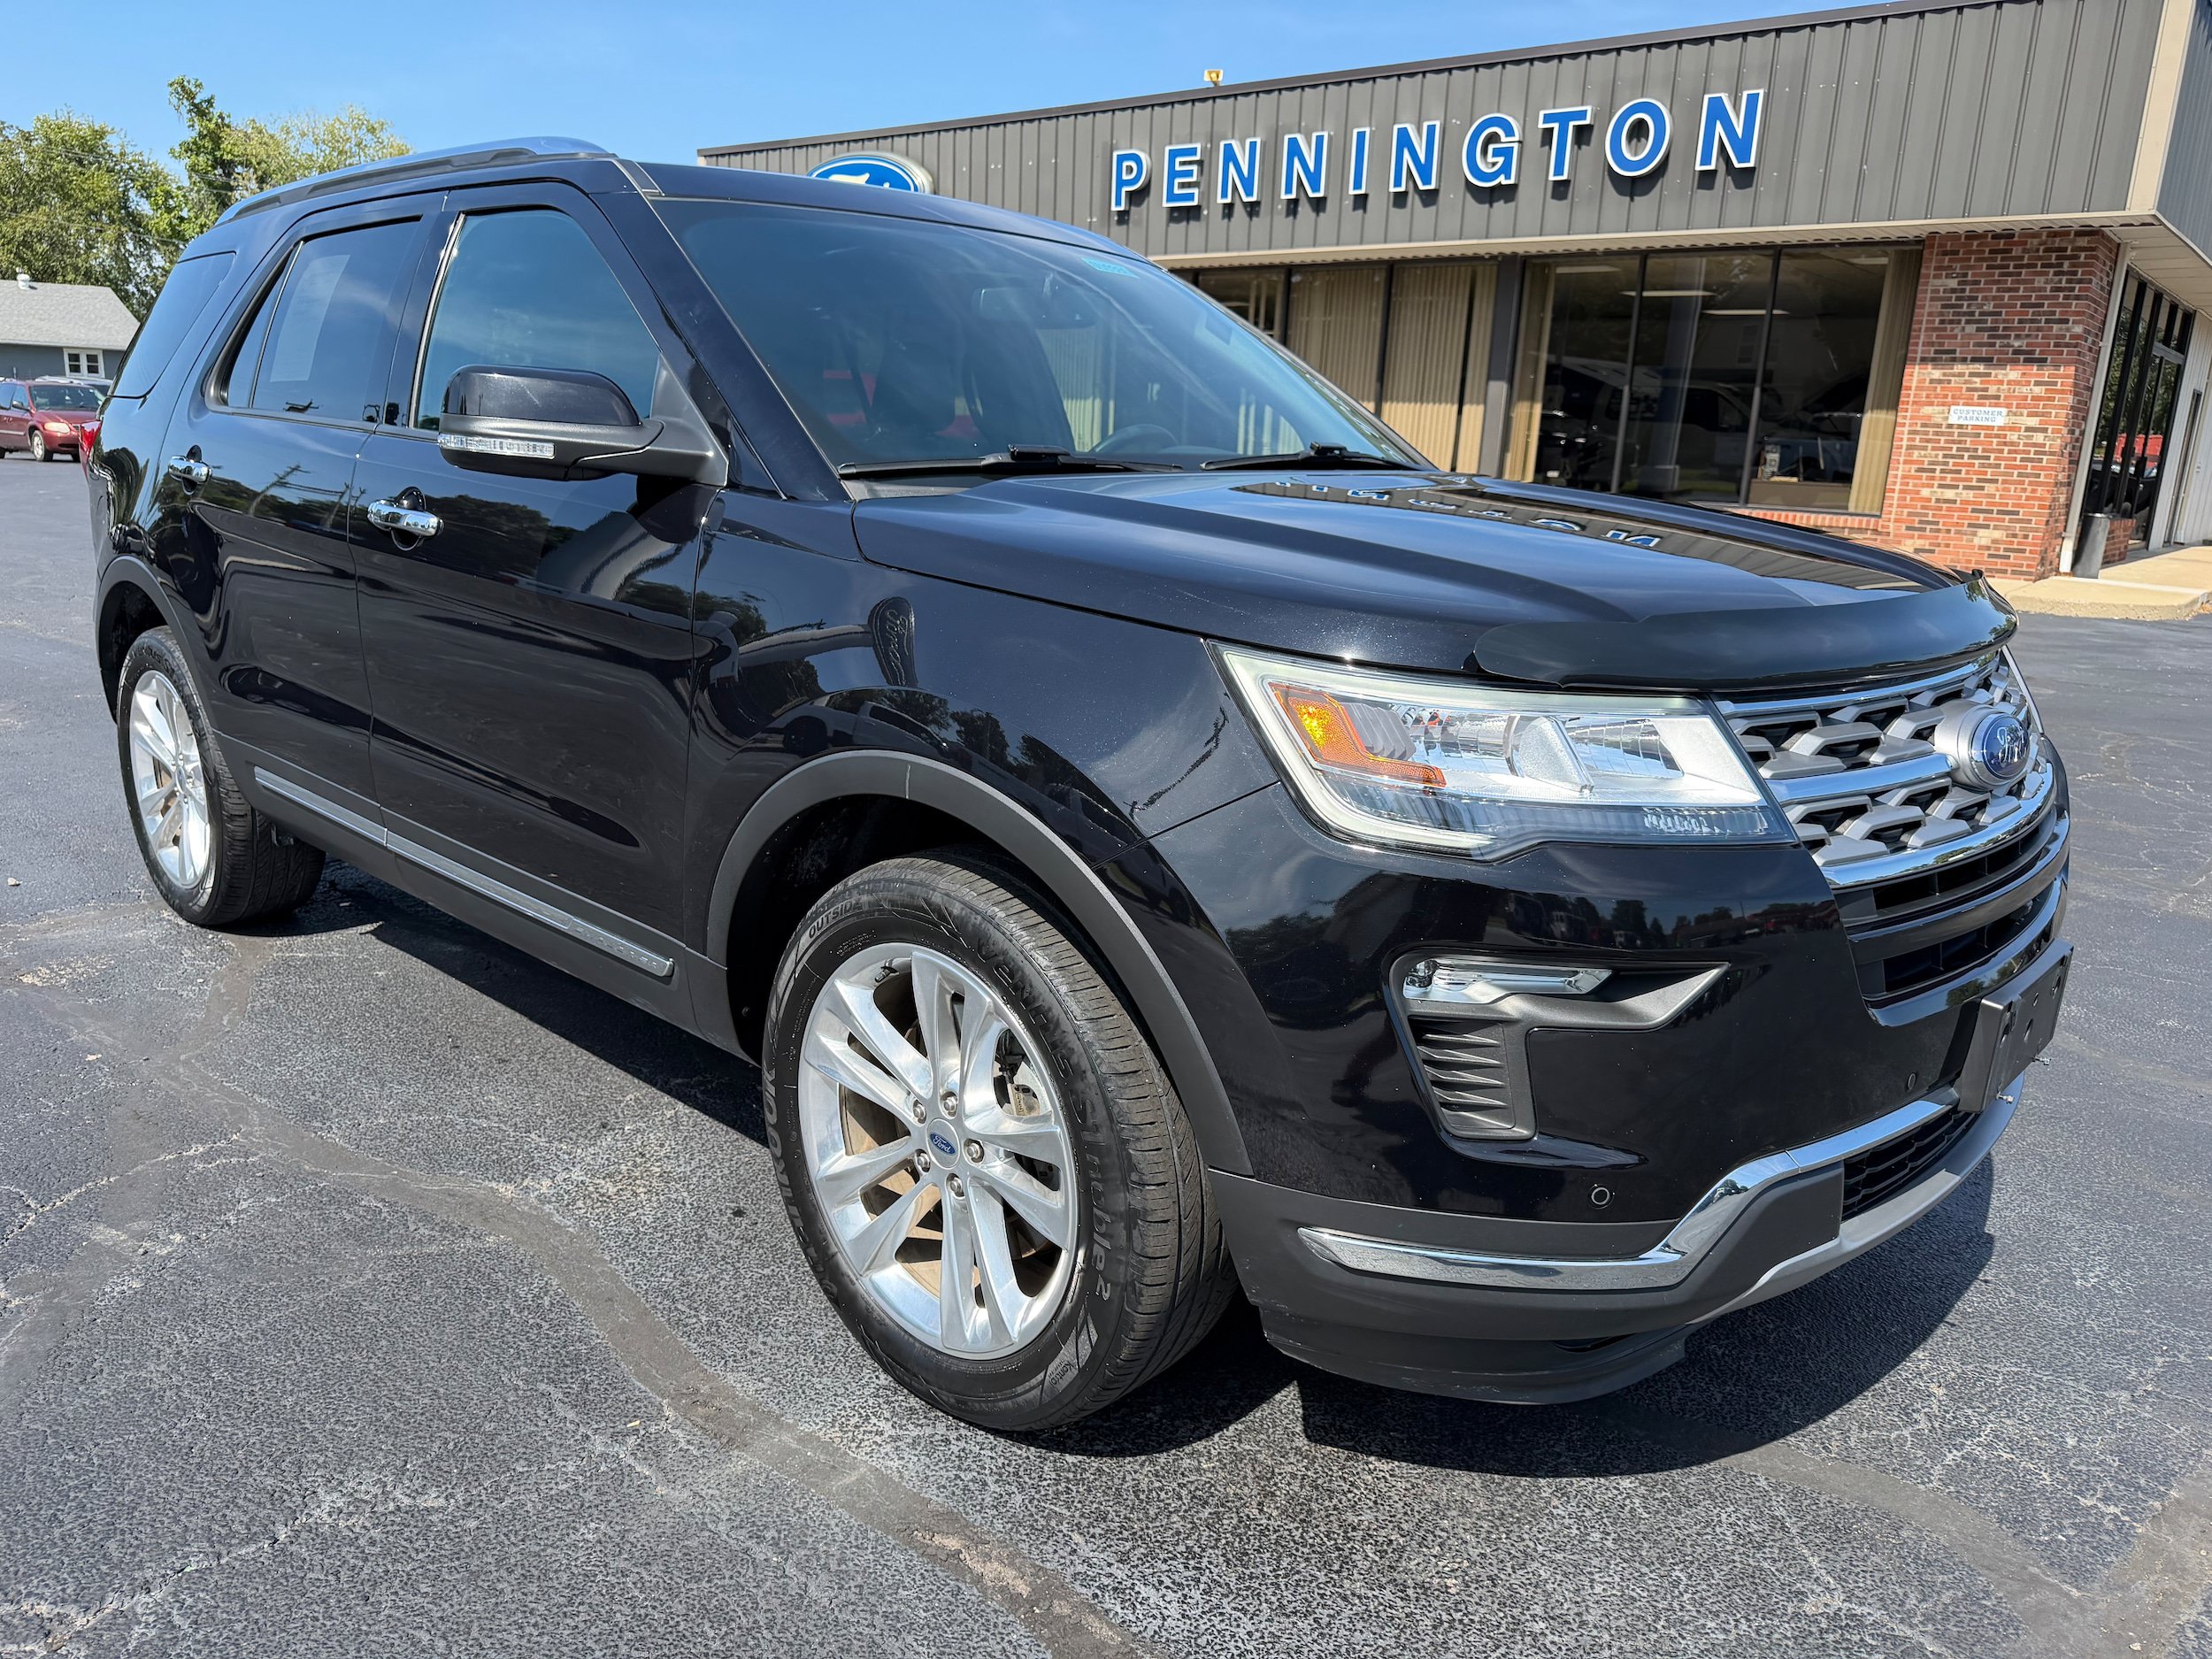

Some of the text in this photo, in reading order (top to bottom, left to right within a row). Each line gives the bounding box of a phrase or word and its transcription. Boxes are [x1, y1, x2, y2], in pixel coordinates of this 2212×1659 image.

[1111, 88, 1764, 211] PENNINGTON
[1953, 408, 2003, 417] CUSTOMER
[933, 1135, 951, 1153] Ford
